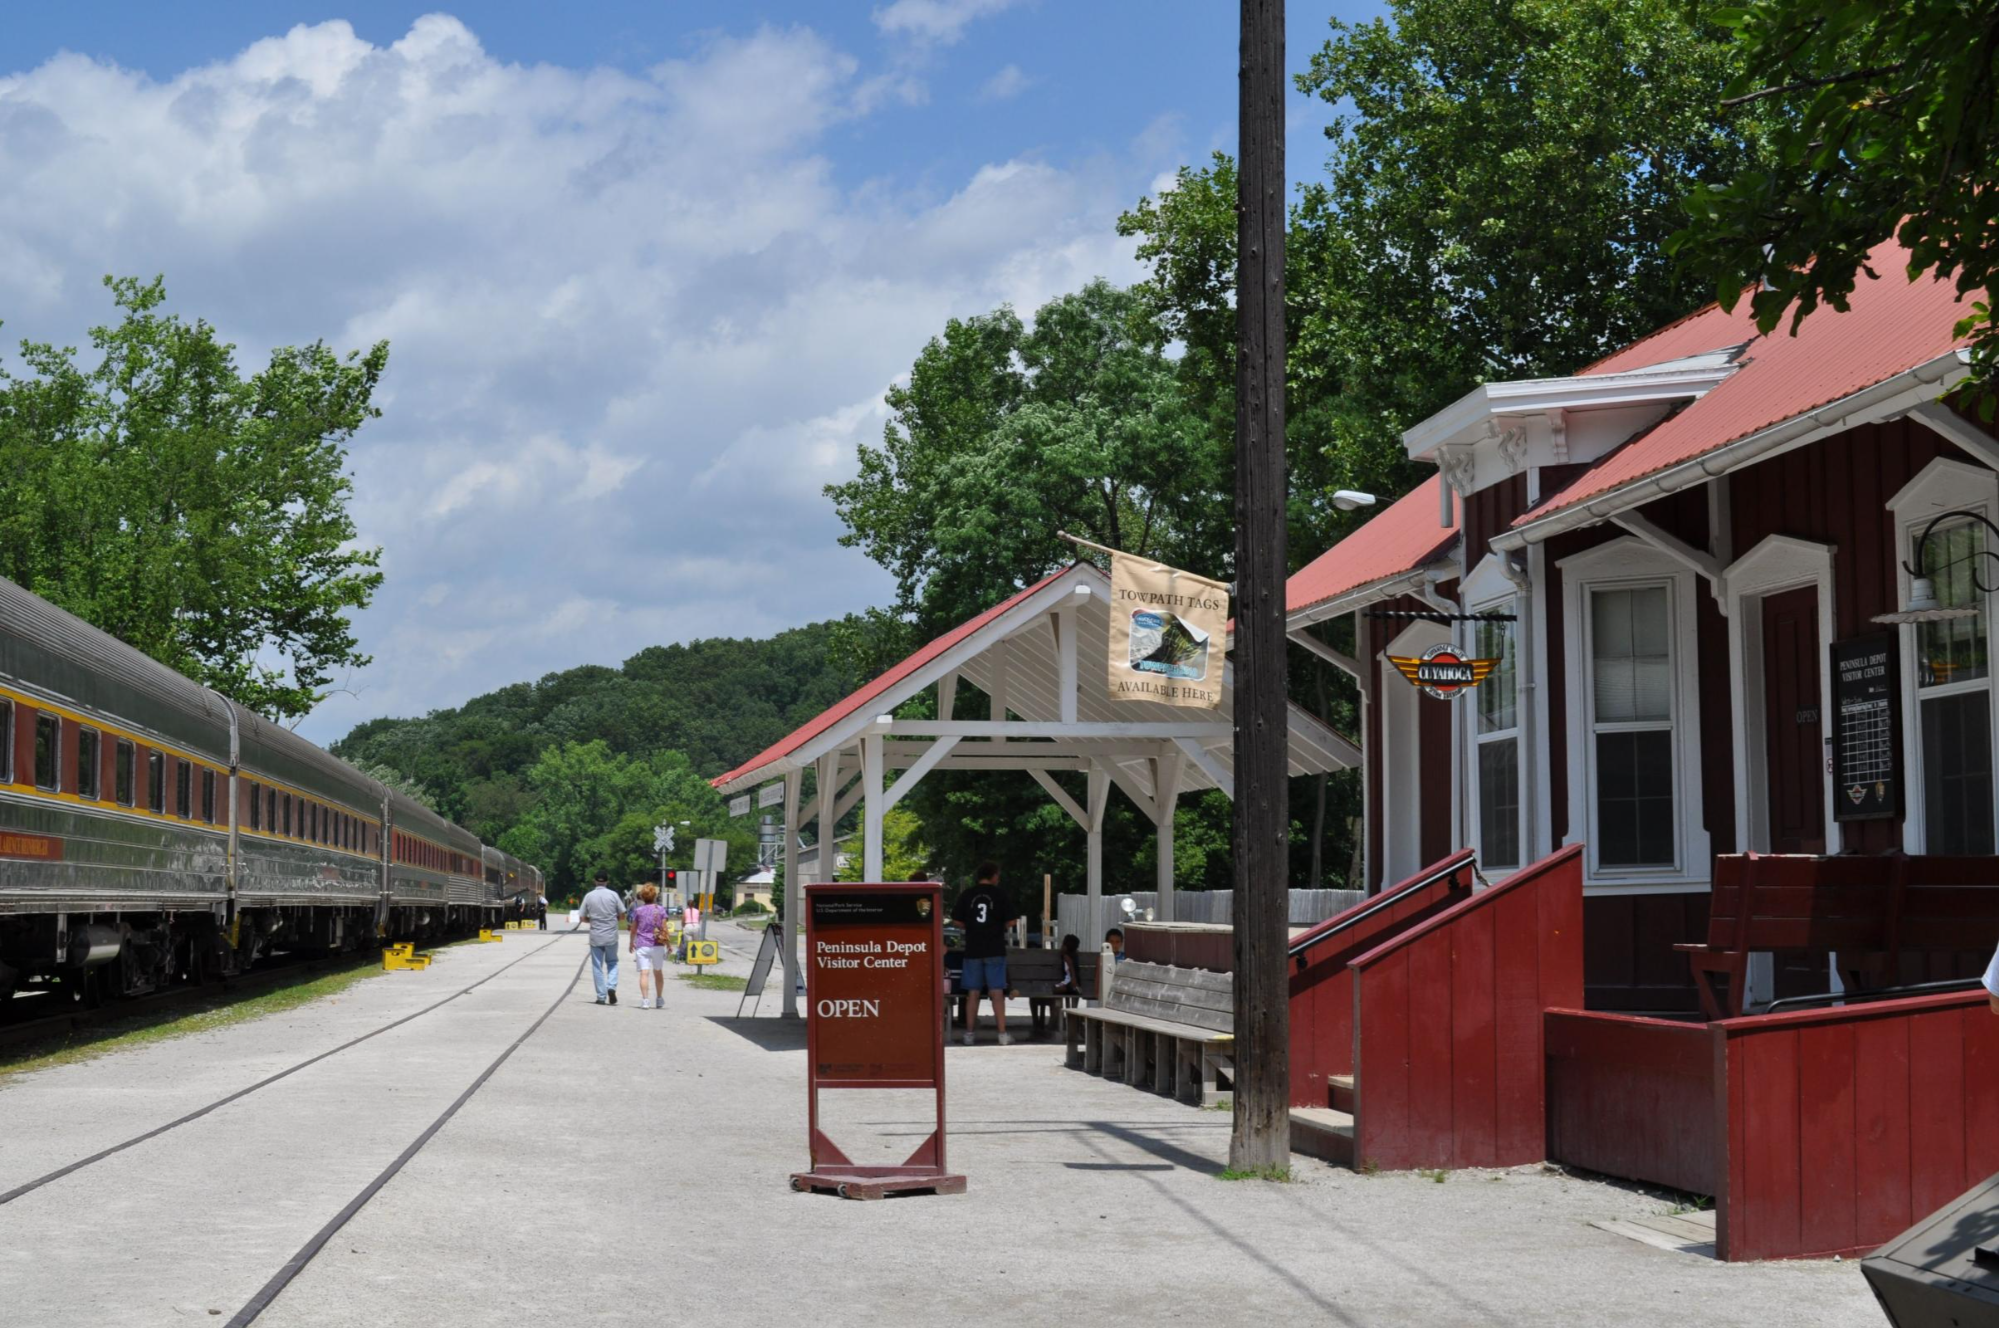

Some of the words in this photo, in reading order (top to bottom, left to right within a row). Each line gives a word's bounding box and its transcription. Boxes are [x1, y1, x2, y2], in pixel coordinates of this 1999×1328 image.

[1118, 589, 1184, 607] TOWPATH
[1187, 596, 1220, 611] TAGS
[1840, 657, 1868, 671] PENINSULA
[1869, 653, 1886, 665] DEPOT
[1419, 667, 1471, 680] CUYAHOGA
[1842, 670, 1862, 682] VISITOR
[1864, 666, 1885, 678] CENTER
[1117, 681, 1179, 698] AVAILABLE
[1182, 687, 1214, 702] HERE
[1796, 709, 1818, 724] OPEN
[976, 903, 987, 923] 3
[816, 941, 882, 953] Peninsula
[886, 940, 926, 955] Depot
[816, 956, 860, 968] Visitor
[863, 956, 908, 968] Center
[817, 999, 880, 1018] OPEN
